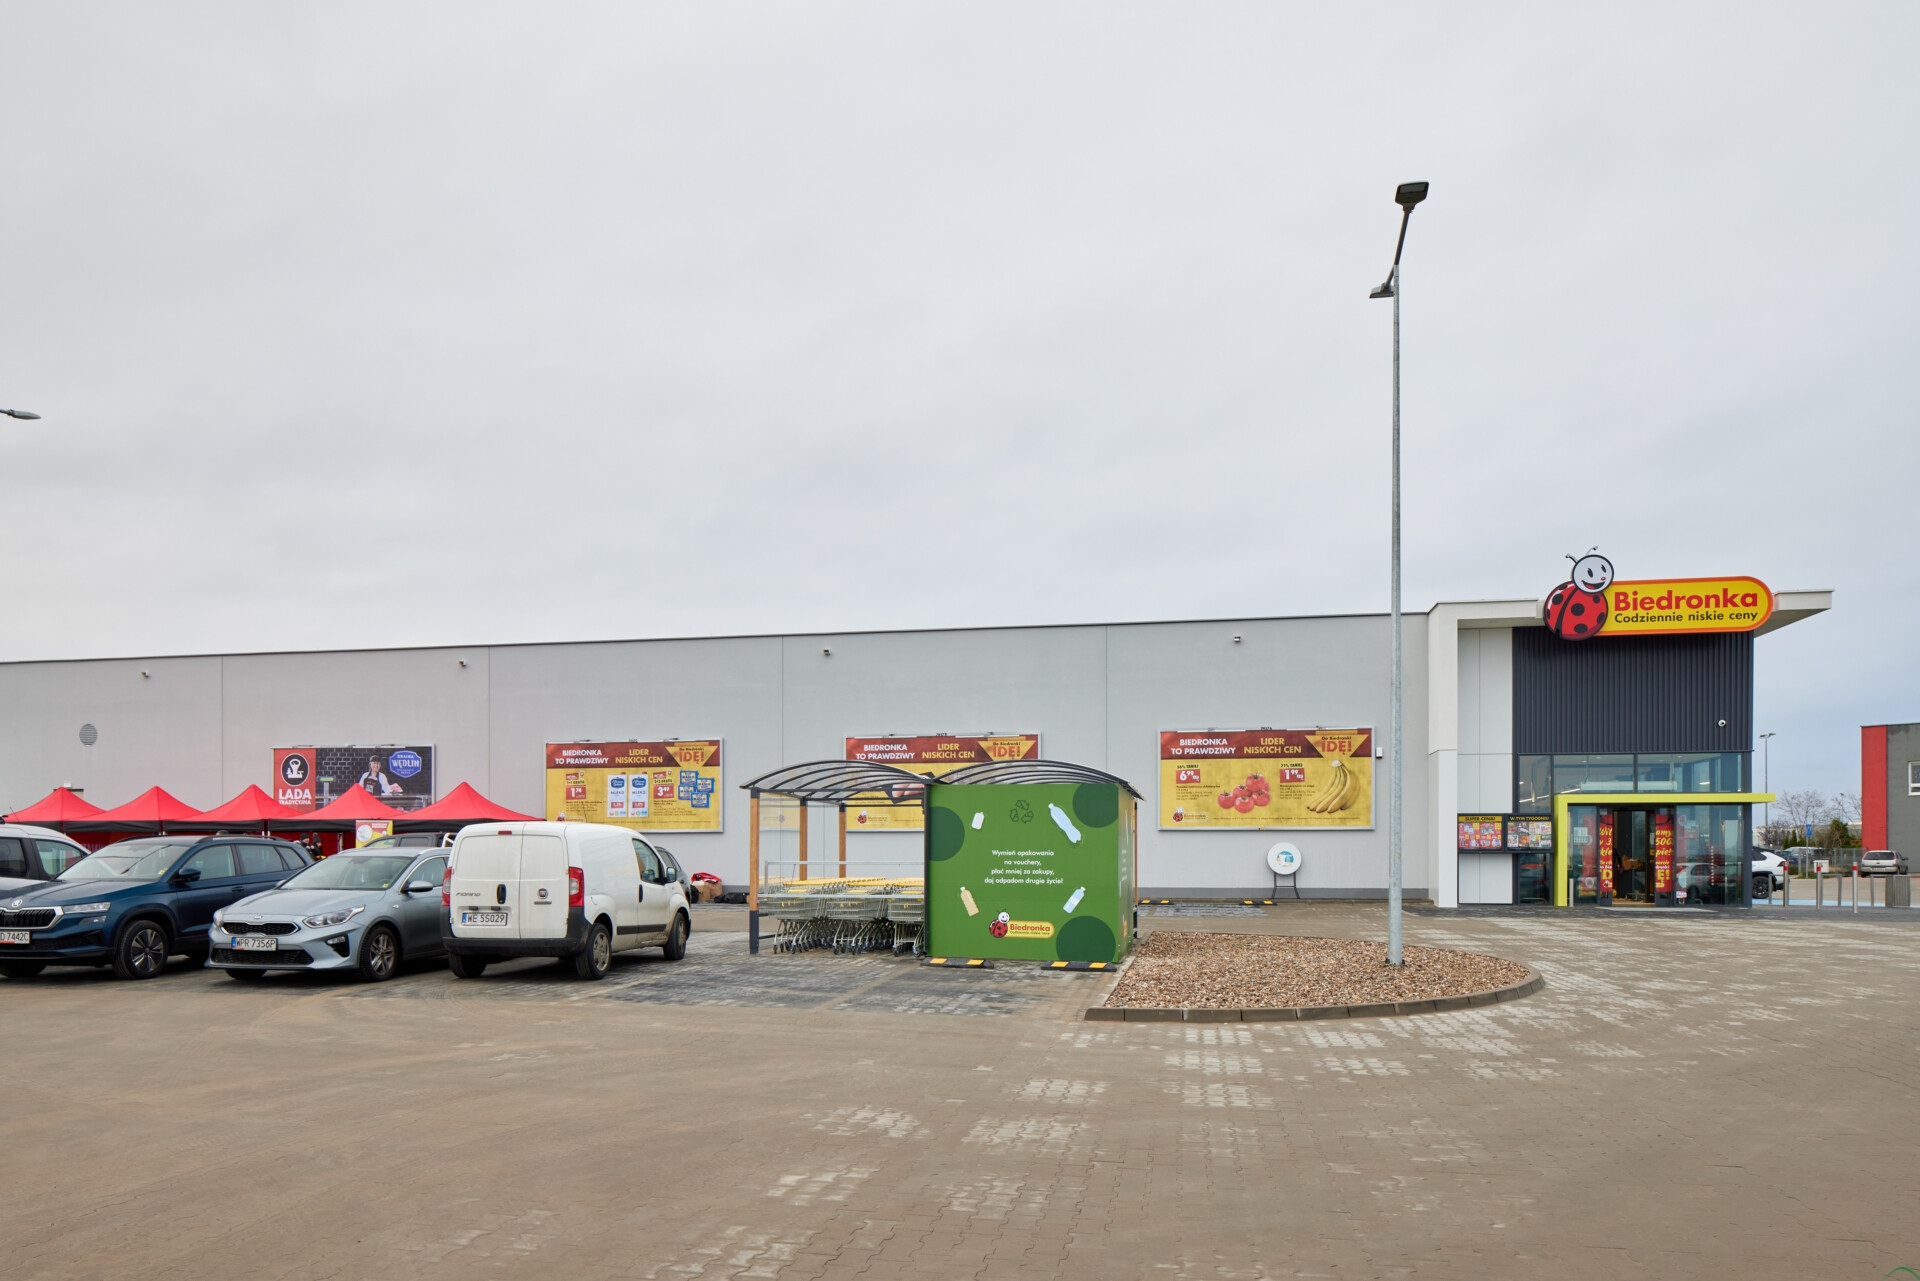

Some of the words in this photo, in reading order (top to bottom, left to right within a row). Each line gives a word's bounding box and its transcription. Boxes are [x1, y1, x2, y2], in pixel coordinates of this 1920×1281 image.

[1614, 588, 1758, 611] Biedronka
[1615, 612, 1683, 623] Codziennie
[1688, 611, 1724, 621] niskie
[1729, 612, 1758, 621] ceny
[1179, 738, 1228, 746] BIEDRONKA
[863, 743, 908, 751] BIEDRONKA
[937, 743, 960, 751] LIDER
[1184, 747, 1236, 755] PRAWDZIWY
[1243, 746, 1282, 754] NISKICH
[1283, 745, 1302, 753] CEN
[1321, 740, 1352, 755] IDĘ!
[562, 749, 602, 757] BIEDRONKA
[628, 748, 649, 756] LIDER
[958, 751, 975, 759] CEN
[992, 745, 1021, 760] IDĘ!
[566, 757, 609, 765] PRAWDZIWY
[615, 756, 647, 764] NISKICH
[648, 756, 663, 764] CEN
[679, 751, 705, 765] IDĘ!
[391, 759, 420, 769] WĘDLIN
[278, 788, 312, 800] LADA
[991, 849, 1016, 857] Wymień
[1017, 849, 1055, 857] opakowania
[1031, 868, 1055, 876] zakupy,
[1025, 877, 1045, 885] drugie
[1046, 877, 1064, 885] życie!
[467, 914, 478, 922] WE
[1009, 923, 1051, 932] Biedronka
[7, 932, 29, 941] 7442C
[236, 938, 250, 948] WPR
[251, 939, 276, 949] 7356P
